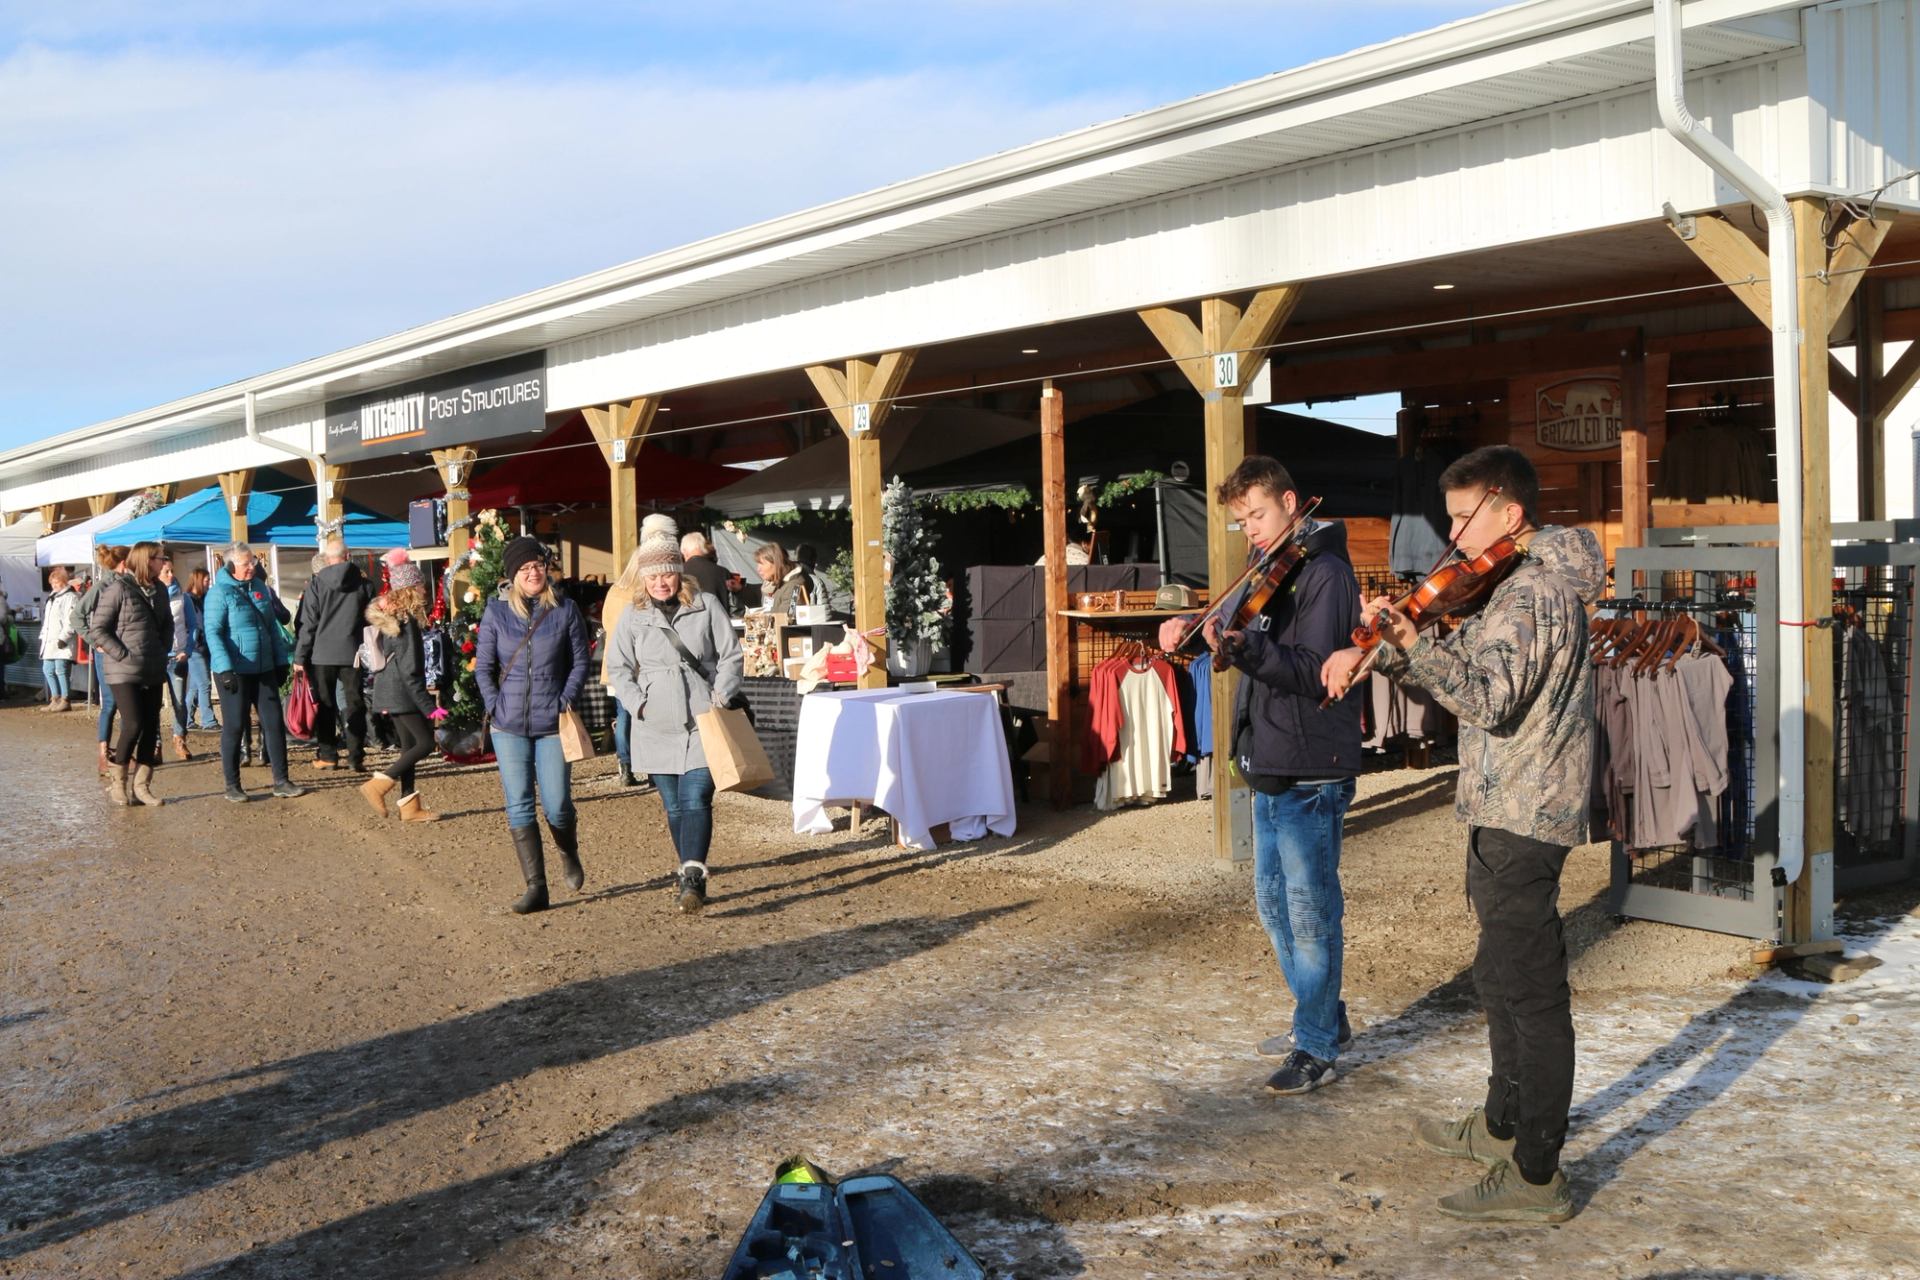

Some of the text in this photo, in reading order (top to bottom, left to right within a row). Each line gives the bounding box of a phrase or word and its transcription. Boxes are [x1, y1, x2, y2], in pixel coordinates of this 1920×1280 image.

[1219, 356, 1233, 385] 30
[361, 391, 425, 440] INTEGRITY
[857, 406, 867, 428] 29
[1541, 416, 1622, 444] GRIZZLED BE
